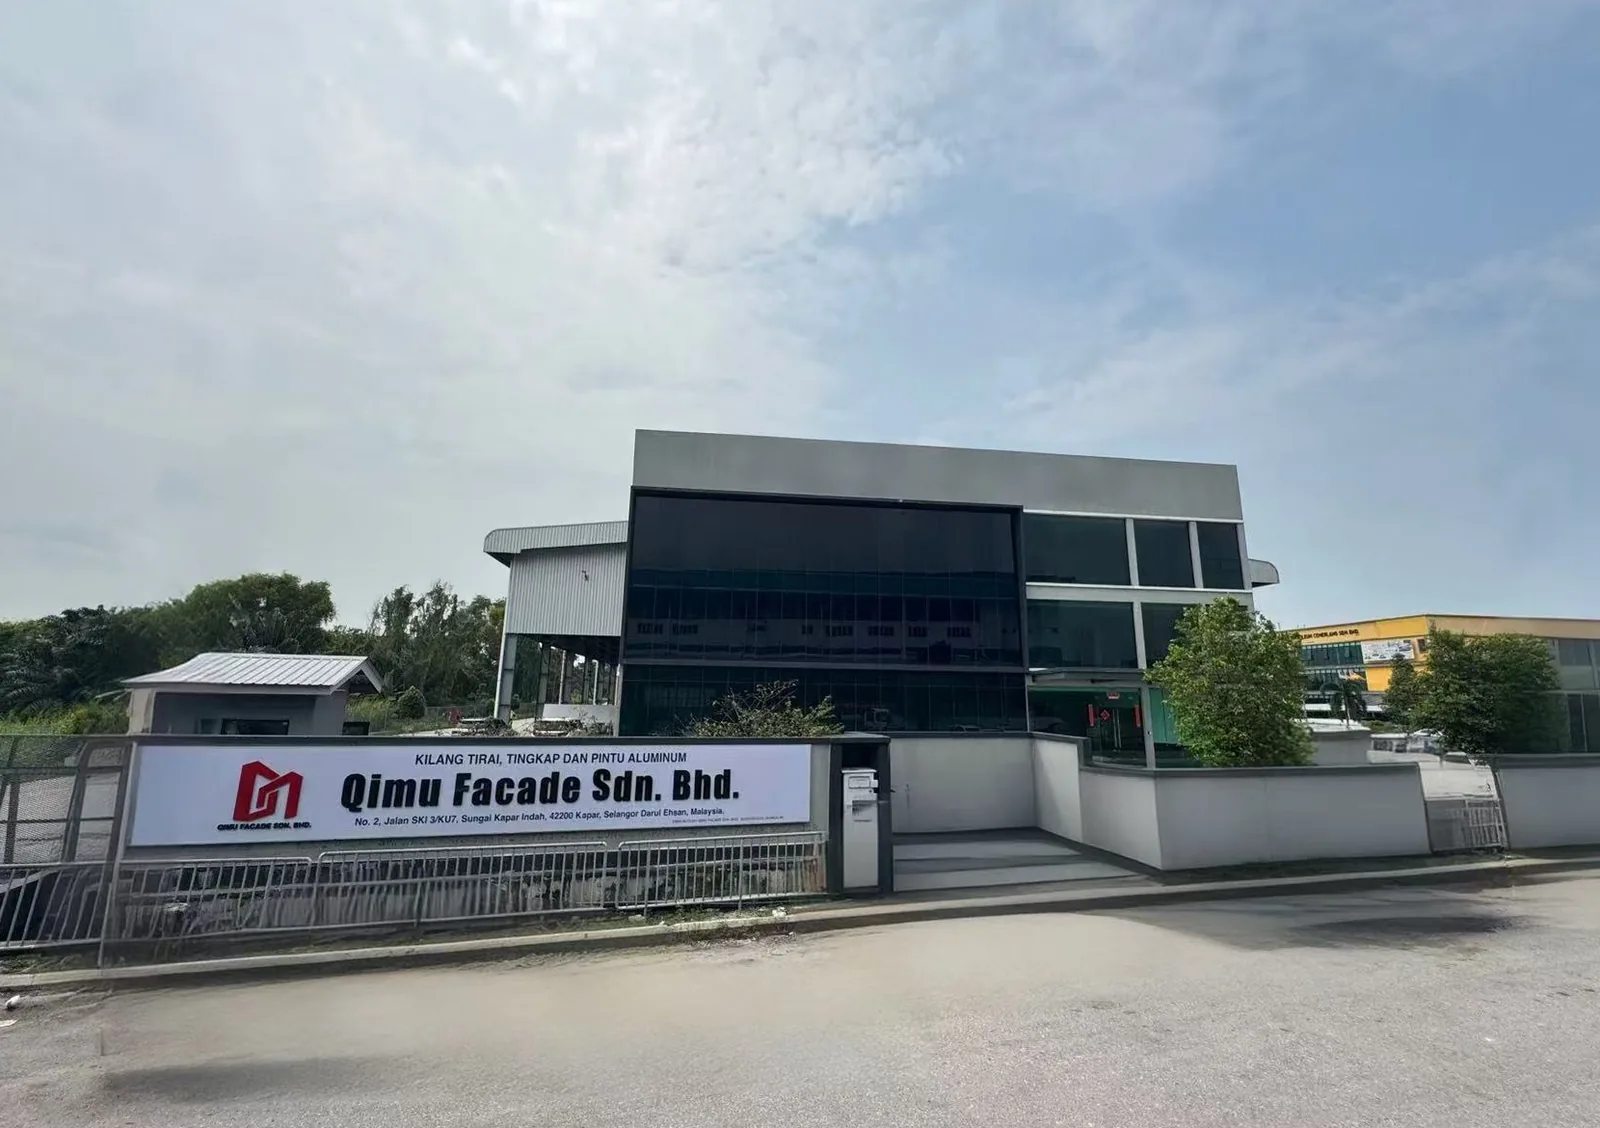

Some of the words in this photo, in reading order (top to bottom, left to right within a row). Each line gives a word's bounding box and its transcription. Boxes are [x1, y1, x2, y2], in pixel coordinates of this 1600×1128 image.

[415, 754, 464, 765] KILANG
[467, 753, 503, 767] TIRAI,
[506, 753, 560, 765] TINGKAP
[563, 753, 588, 764] DAN
[591, 752, 625, 764] PINTU
[627, 752, 687, 763] ALUMINUM
[340, 773, 442, 813] Qimu
[452, 771, 581, 807] Facade
[592, 768, 662, 802] Sdn.
[672, 768, 740, 801] Bhd.
[354, 817, 371, 827] No.
[373, 817, 382, 827] 2,
[384, 816, 409, 826] Jalan
[411, 816, 428, 825] SKI
[429, 815, 459, 825] 3/KU7,
[461, 814, 492, 825] Sungai
[494, 813, 519, 824] Kapar
[521, 812, 547, 822] Indah,
[549, 812, 574, 821] 42200
[575, 810, 602, 821] Kapar,
[603, 809, 639, 820] Selangor
[640, 808, 662, 818] Darul
[663, 808, 689, 818] Ehsan,
[690, 807, 725, 817] Malaysia.
[239, 823, 272, 831] FACADE
